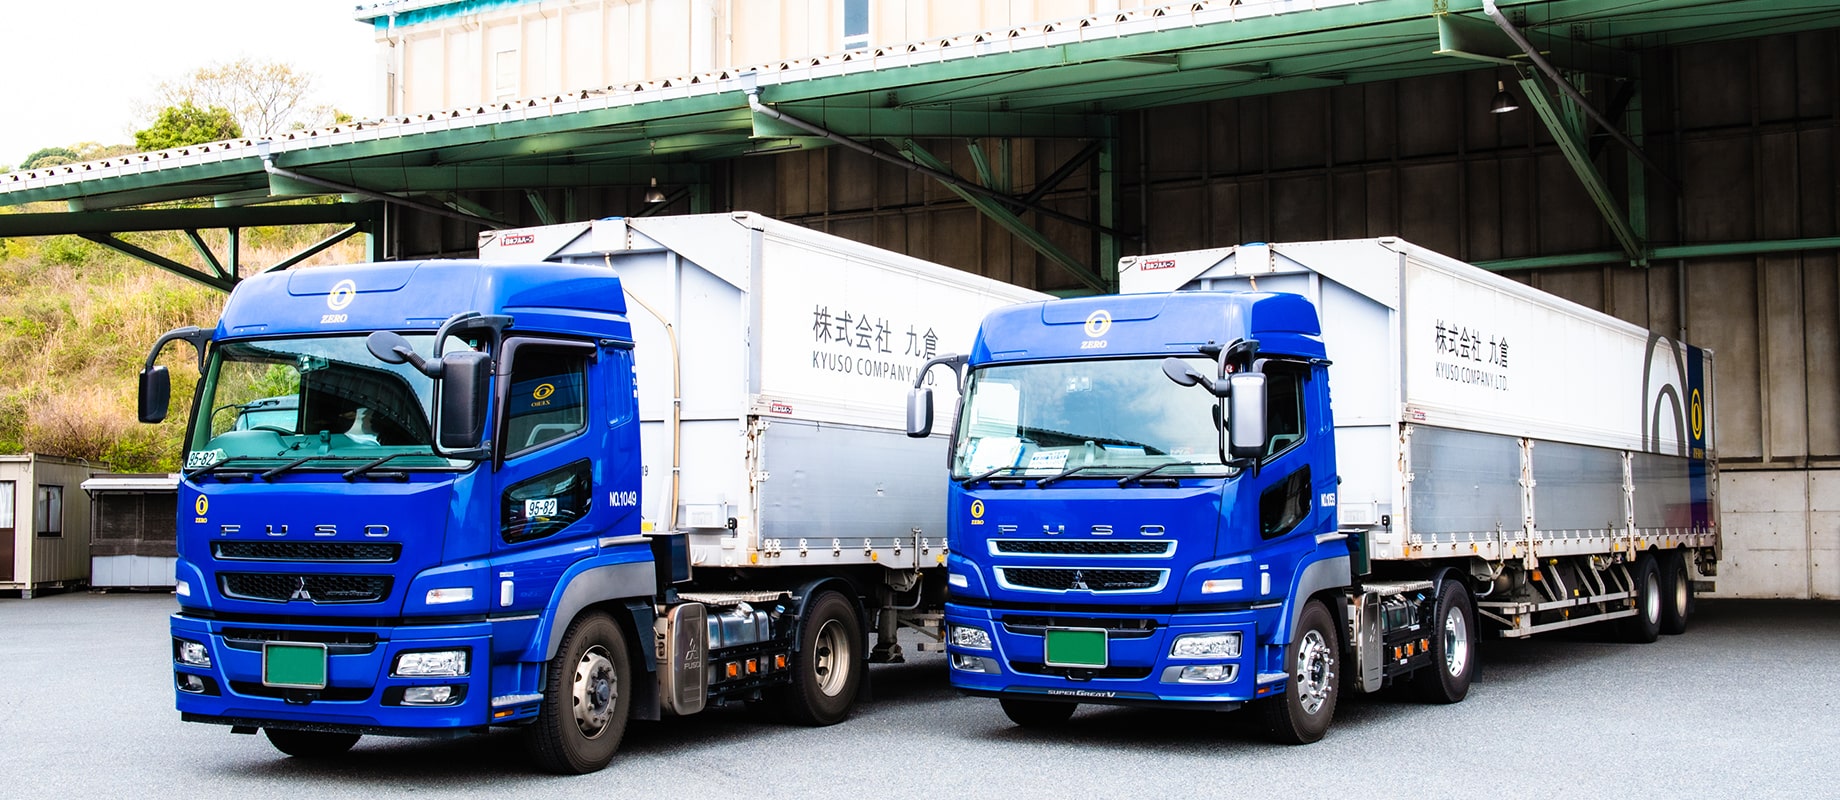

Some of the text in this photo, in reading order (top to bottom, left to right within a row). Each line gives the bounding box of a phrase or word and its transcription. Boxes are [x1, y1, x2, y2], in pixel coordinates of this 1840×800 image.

[320, 313, 348, 324] ZERO
[812, 304, 892, 354] 株式会社
[1080, 340, 1107, 349] ZERO
[1435, 318, 1509, 368] 株式会社 九倉
[812, 350, 852, 374] KYUSO
[1435, 361, 1460, 381] KYUSO
[188, 452, 215, 466] 95-82
[529, 500, 556, 515] 95-82
[220, 524, 390, 538] FUSO
[997, 524, 1165, 536] FUSO
